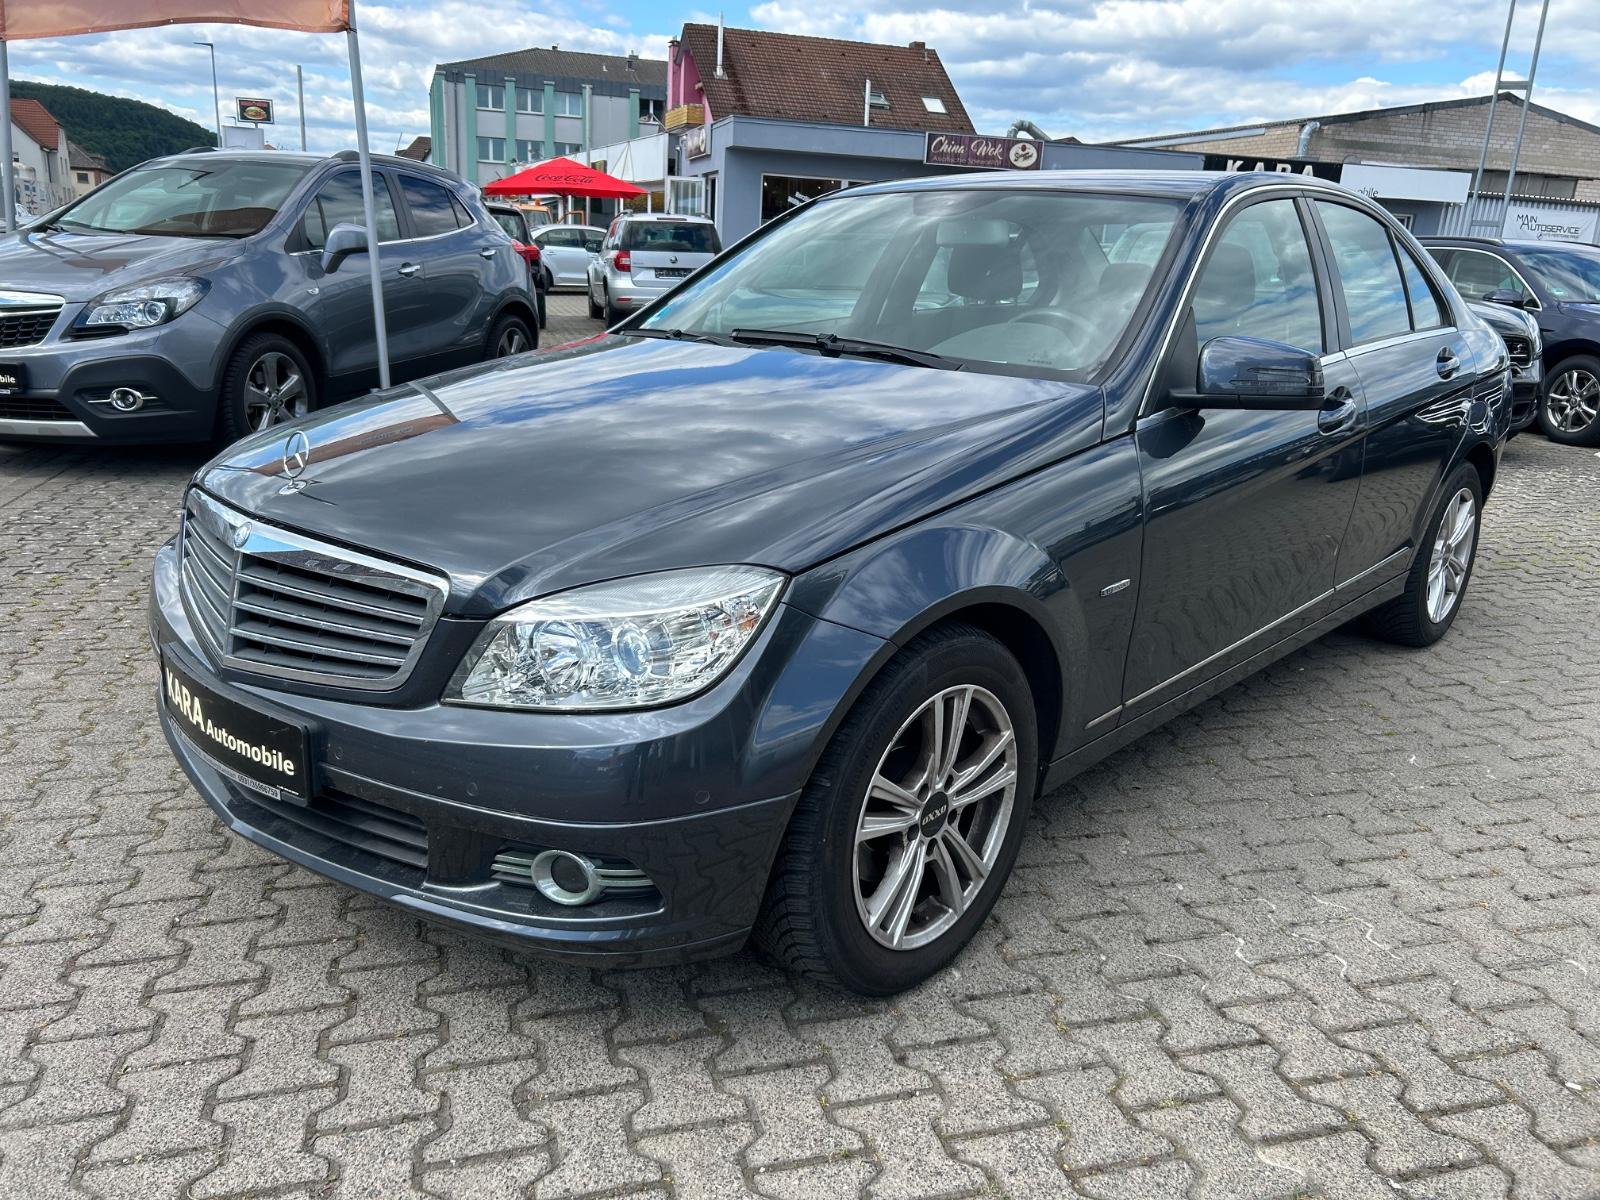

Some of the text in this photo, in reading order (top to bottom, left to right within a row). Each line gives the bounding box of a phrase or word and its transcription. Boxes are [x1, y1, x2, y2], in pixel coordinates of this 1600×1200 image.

[931, 136, 966, 153] China
[971, 139, 1004, 159] Wok
[1520, 218, 1581, 235] AUTOSERVICE
[166, 667, 205, 732] KARA
[206, 719, 295, 776] Automobile
